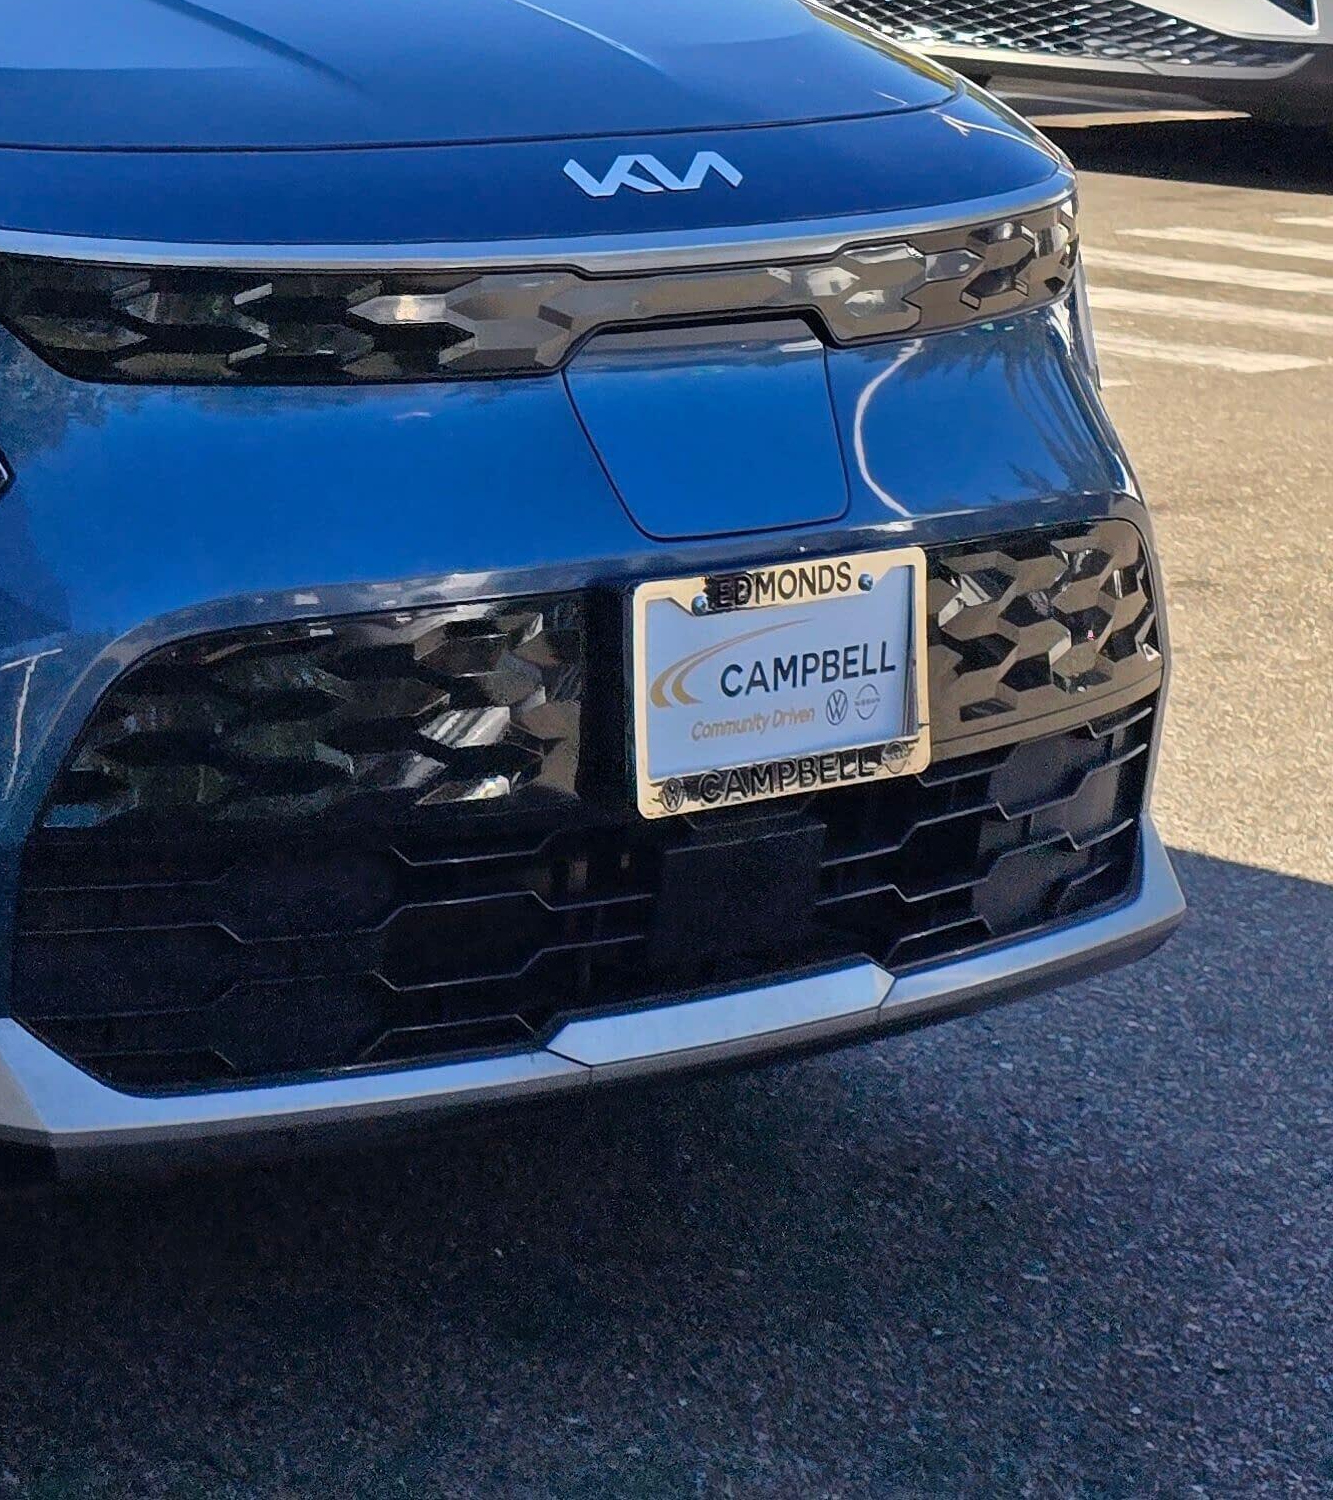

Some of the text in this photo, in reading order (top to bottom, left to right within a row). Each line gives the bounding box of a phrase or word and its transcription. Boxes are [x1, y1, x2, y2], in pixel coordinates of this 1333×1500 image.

[563, 151, 744, 198] KIA
[717, 561, 852, 608] EDMONDS
[720, 641, 897, 698] CAMPBELL
[691, 706, 815, 741] Community Driven
[826, 689, 849, 726] VW
[699, 750, 876, 804] CAMPBELL
